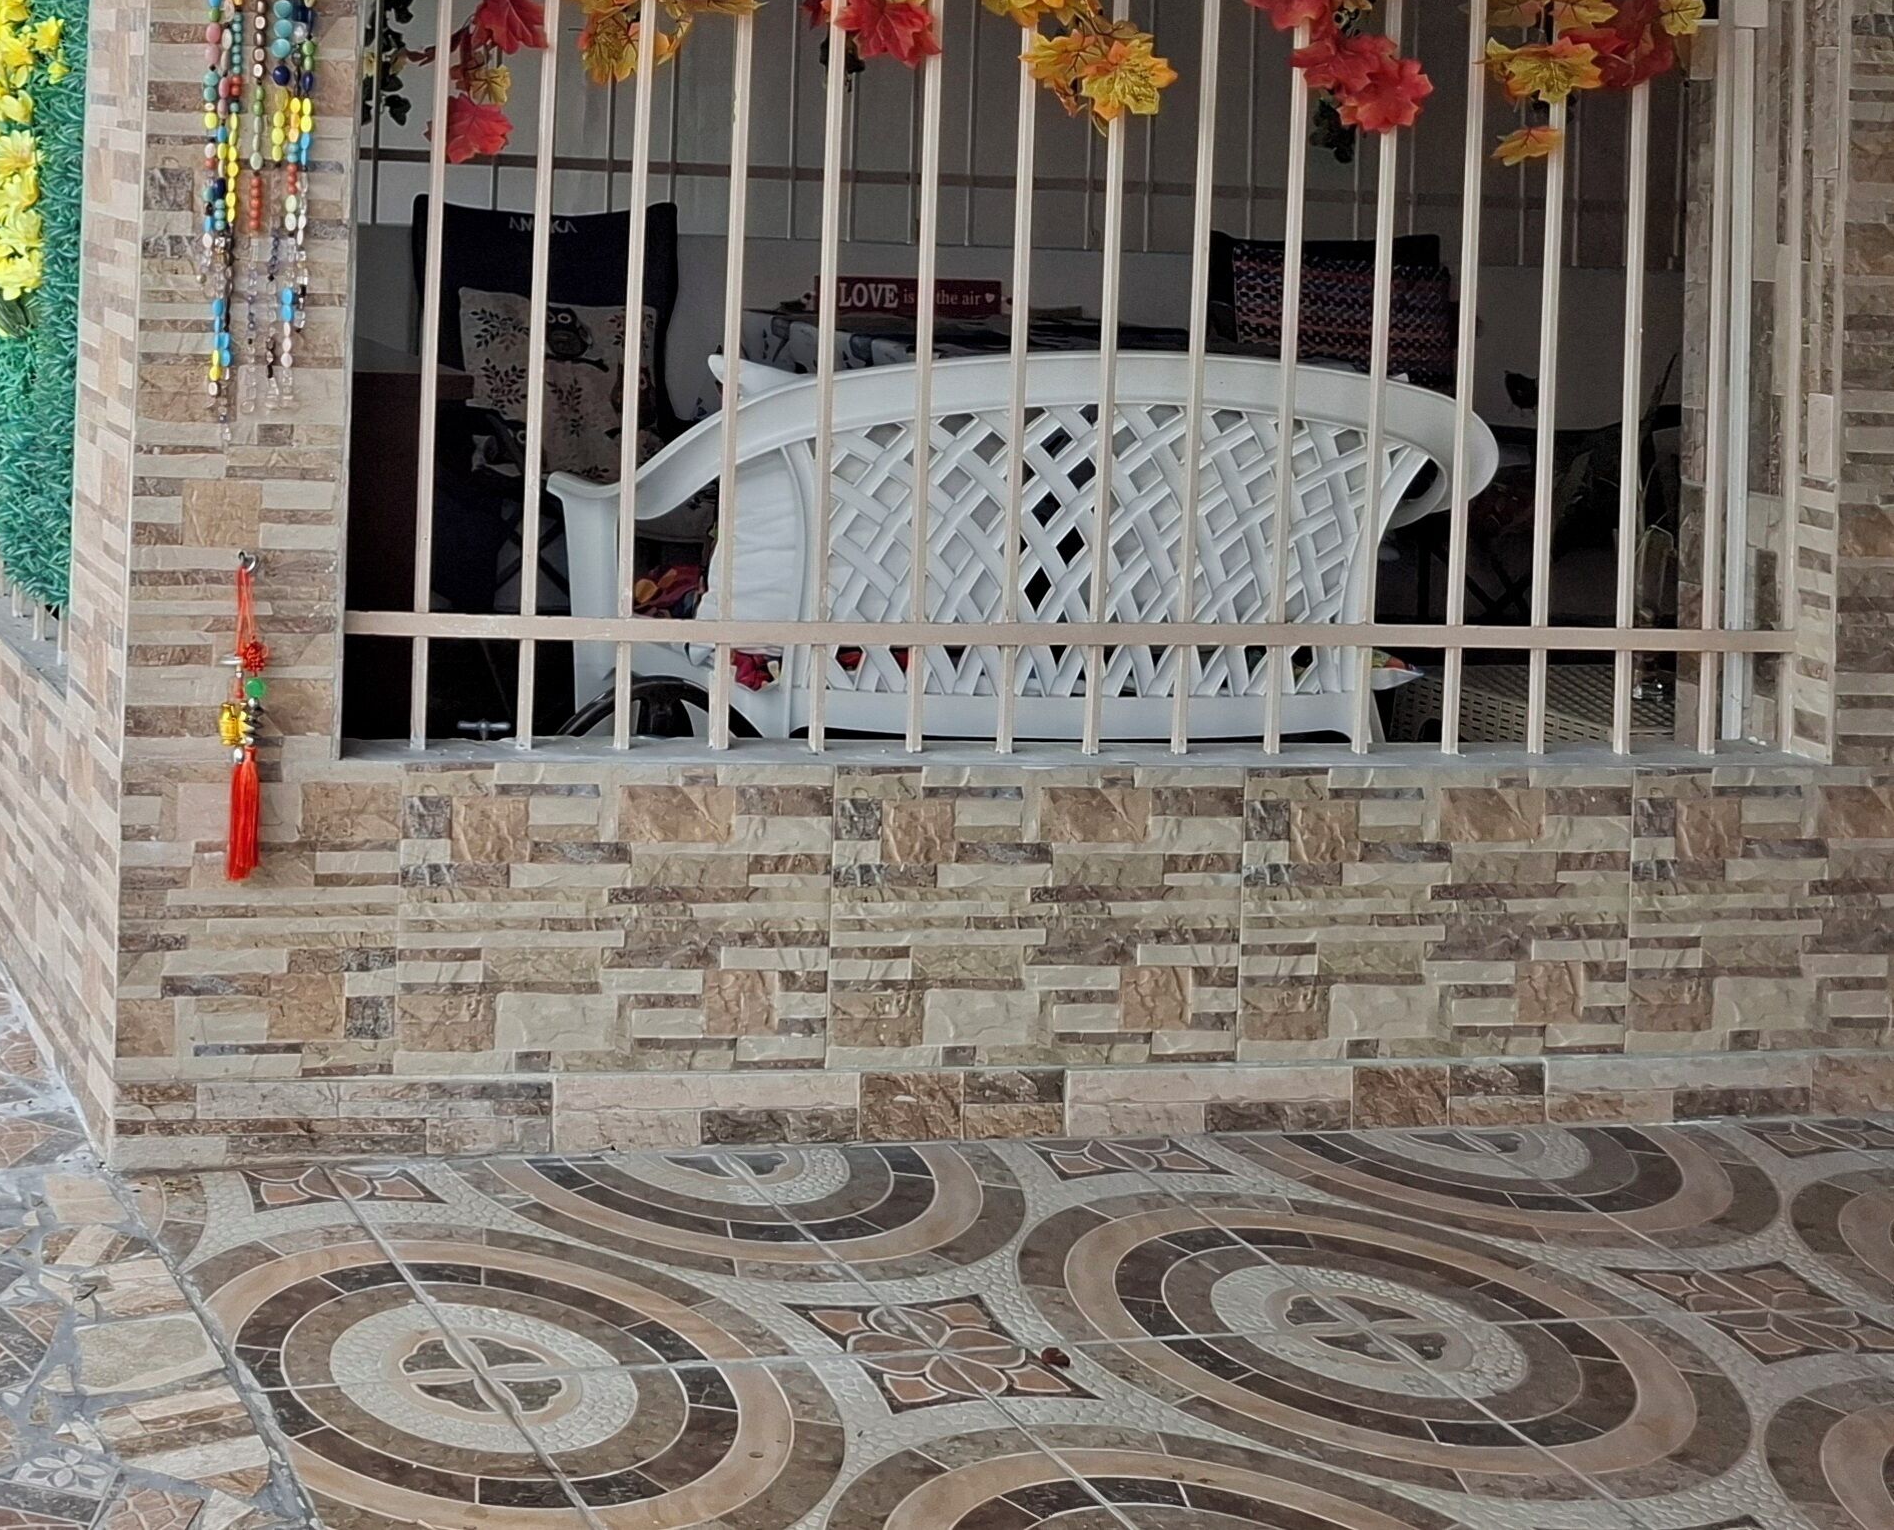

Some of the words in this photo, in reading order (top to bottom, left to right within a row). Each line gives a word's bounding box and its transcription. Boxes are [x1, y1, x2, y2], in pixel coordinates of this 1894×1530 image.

[838, 283, 899, 309] LOVE
[903, 288, 915, 305] is
[935, 289, 958, 306] the
[961, 291, 981, 306] air
